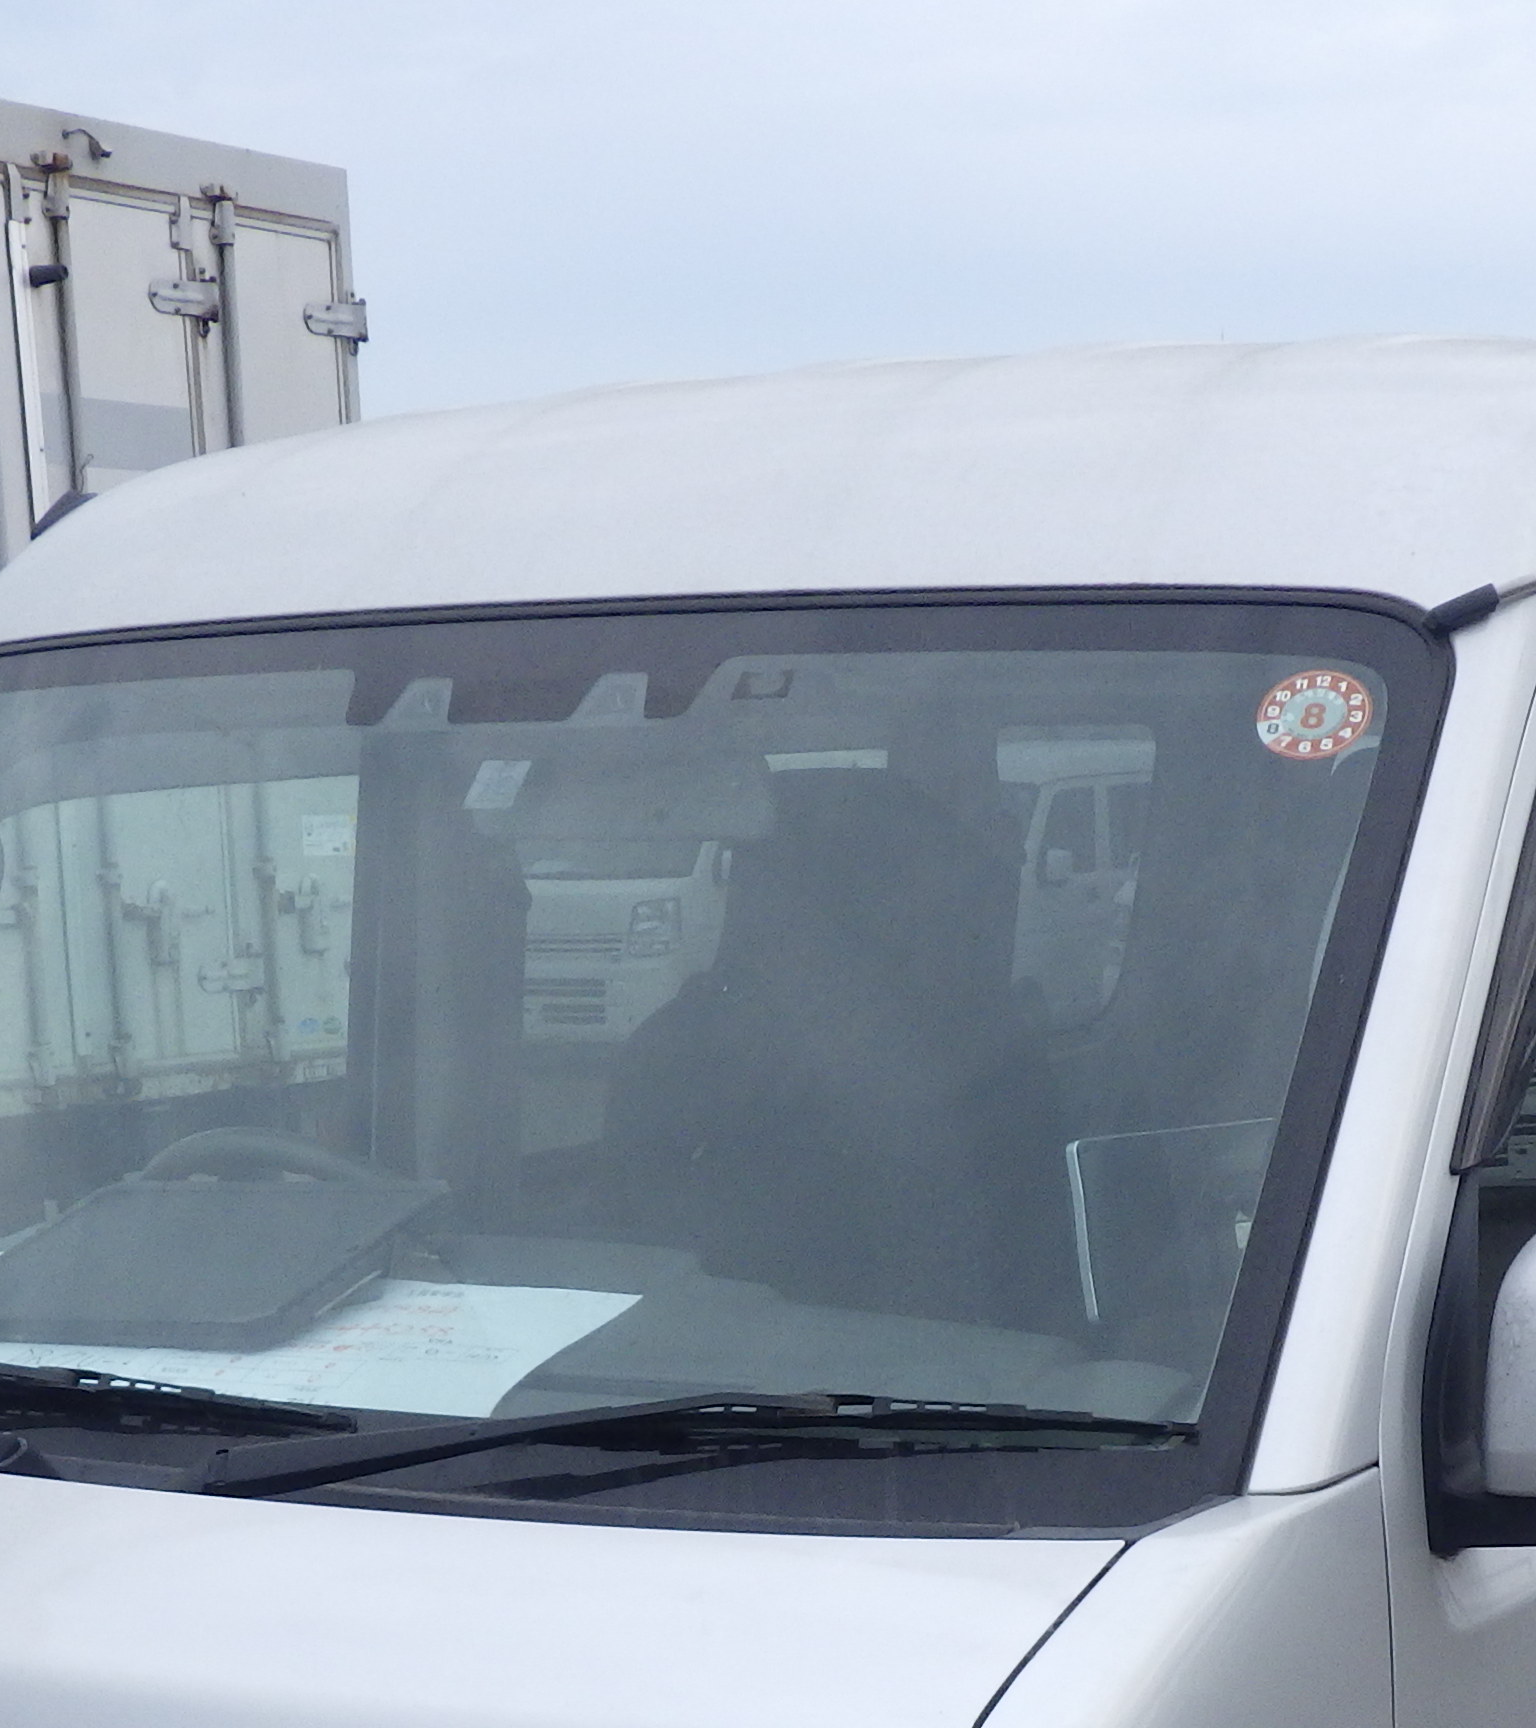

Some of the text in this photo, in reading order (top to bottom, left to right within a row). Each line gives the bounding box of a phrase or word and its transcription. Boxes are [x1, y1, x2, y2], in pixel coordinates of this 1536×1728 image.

[1295, 678, 1309, 690] 11
[1316, 675, 1332, 687] 12
[1338, 681, 1349, 692] 1
[1275, 690, 1292, 702] 10
[1349, 693, 1363, 706] 2
[1300, 702, 1327, 729] 8
[1279, 735, 1293, 748] 7
